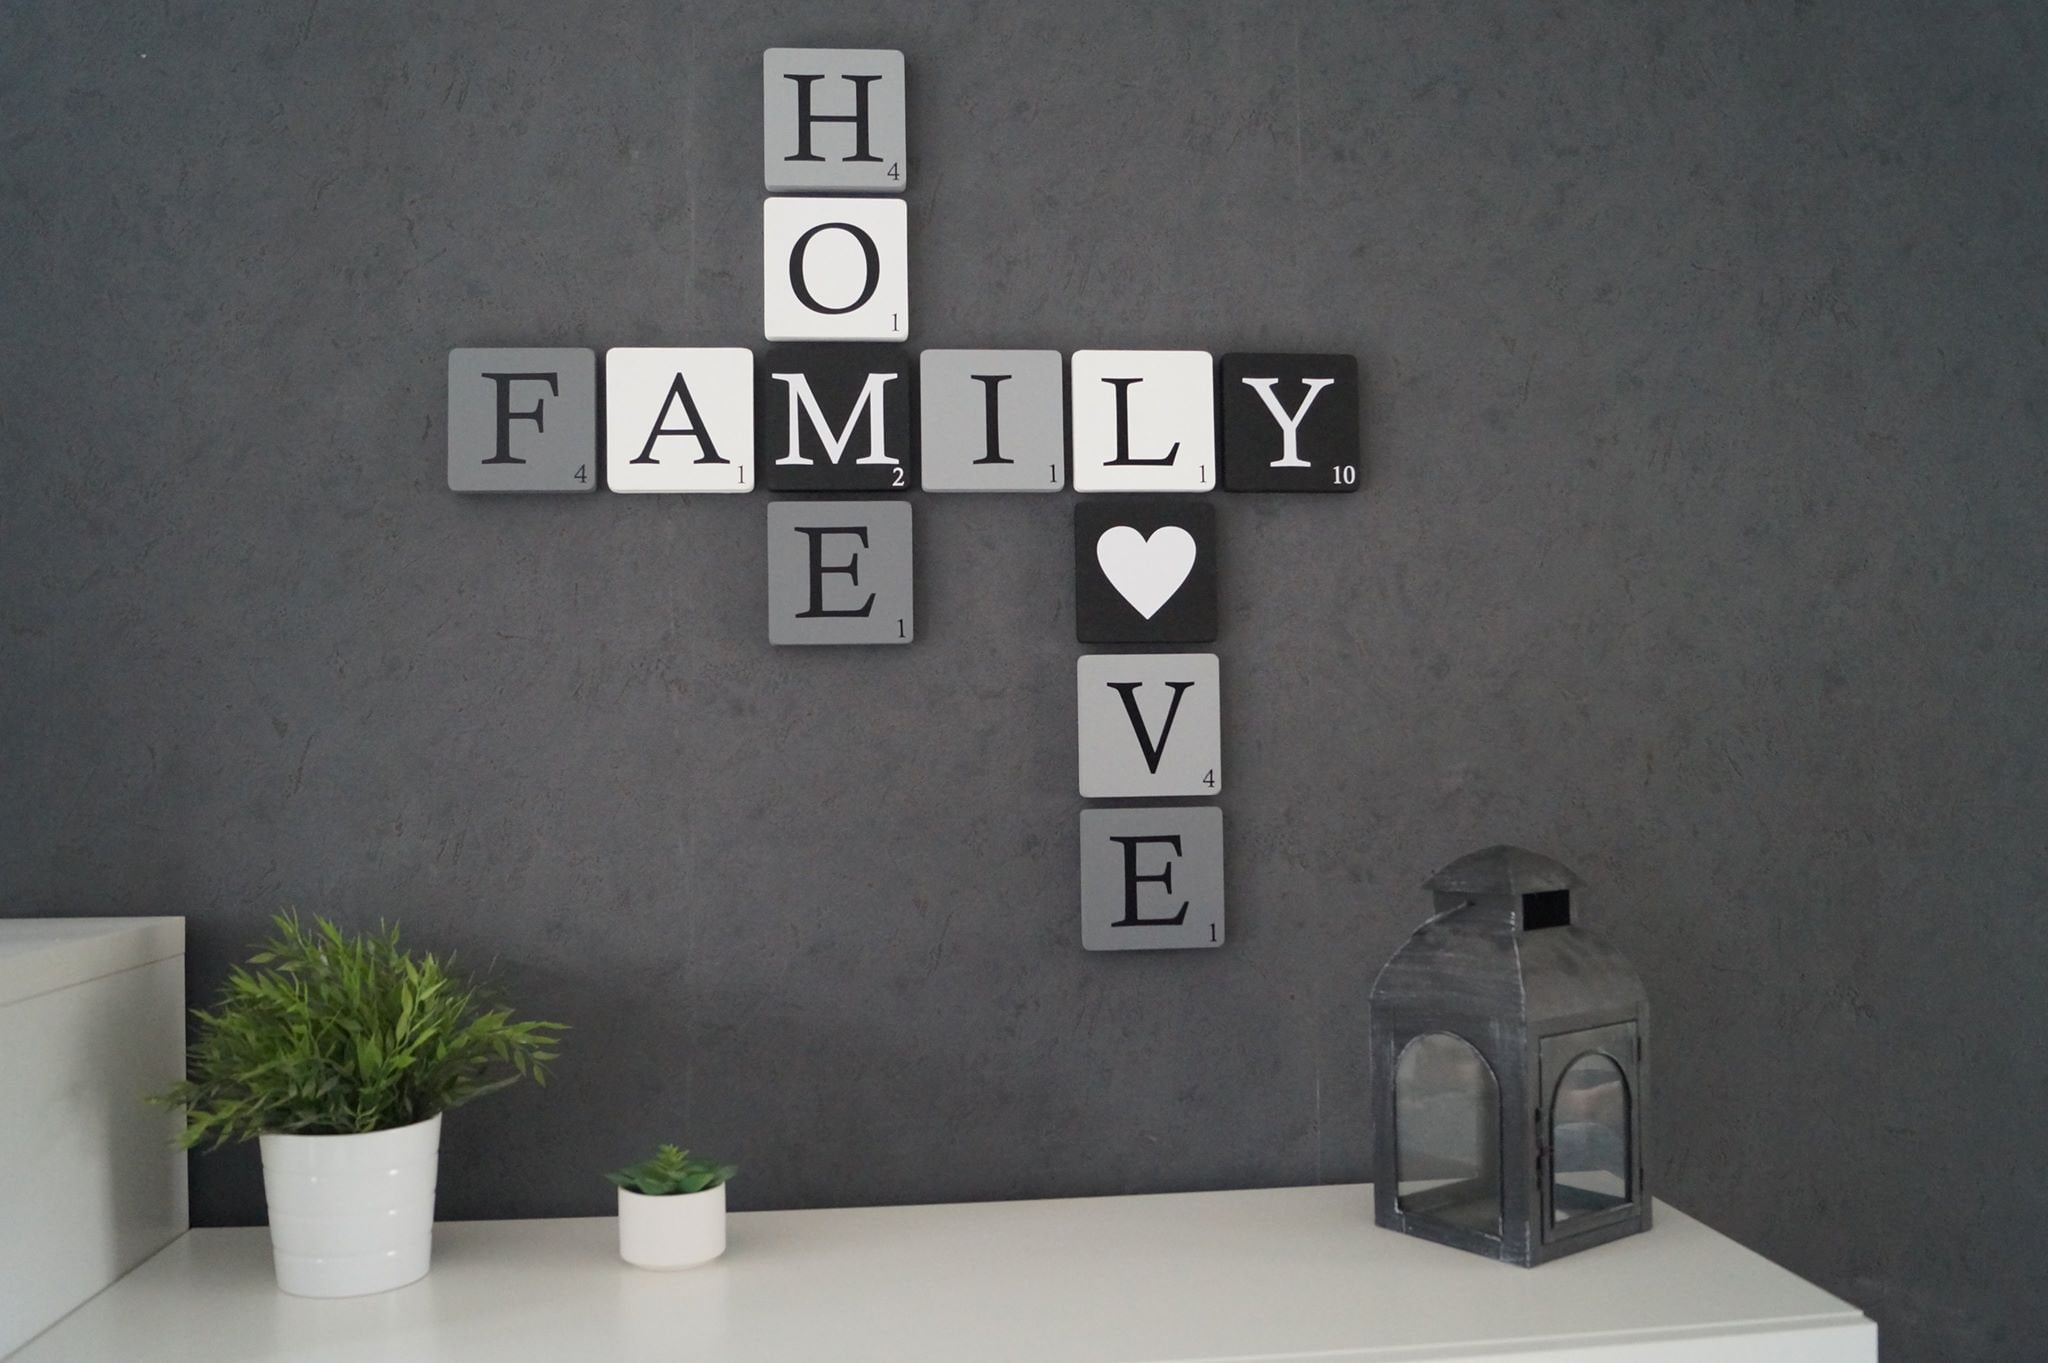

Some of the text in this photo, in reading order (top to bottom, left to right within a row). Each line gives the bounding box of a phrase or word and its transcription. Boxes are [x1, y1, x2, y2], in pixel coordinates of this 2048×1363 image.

[887, 162, 900, 181] 4
[1332, 465, 1356, 485] 10
[1202, 769, 1215, 788] 4
